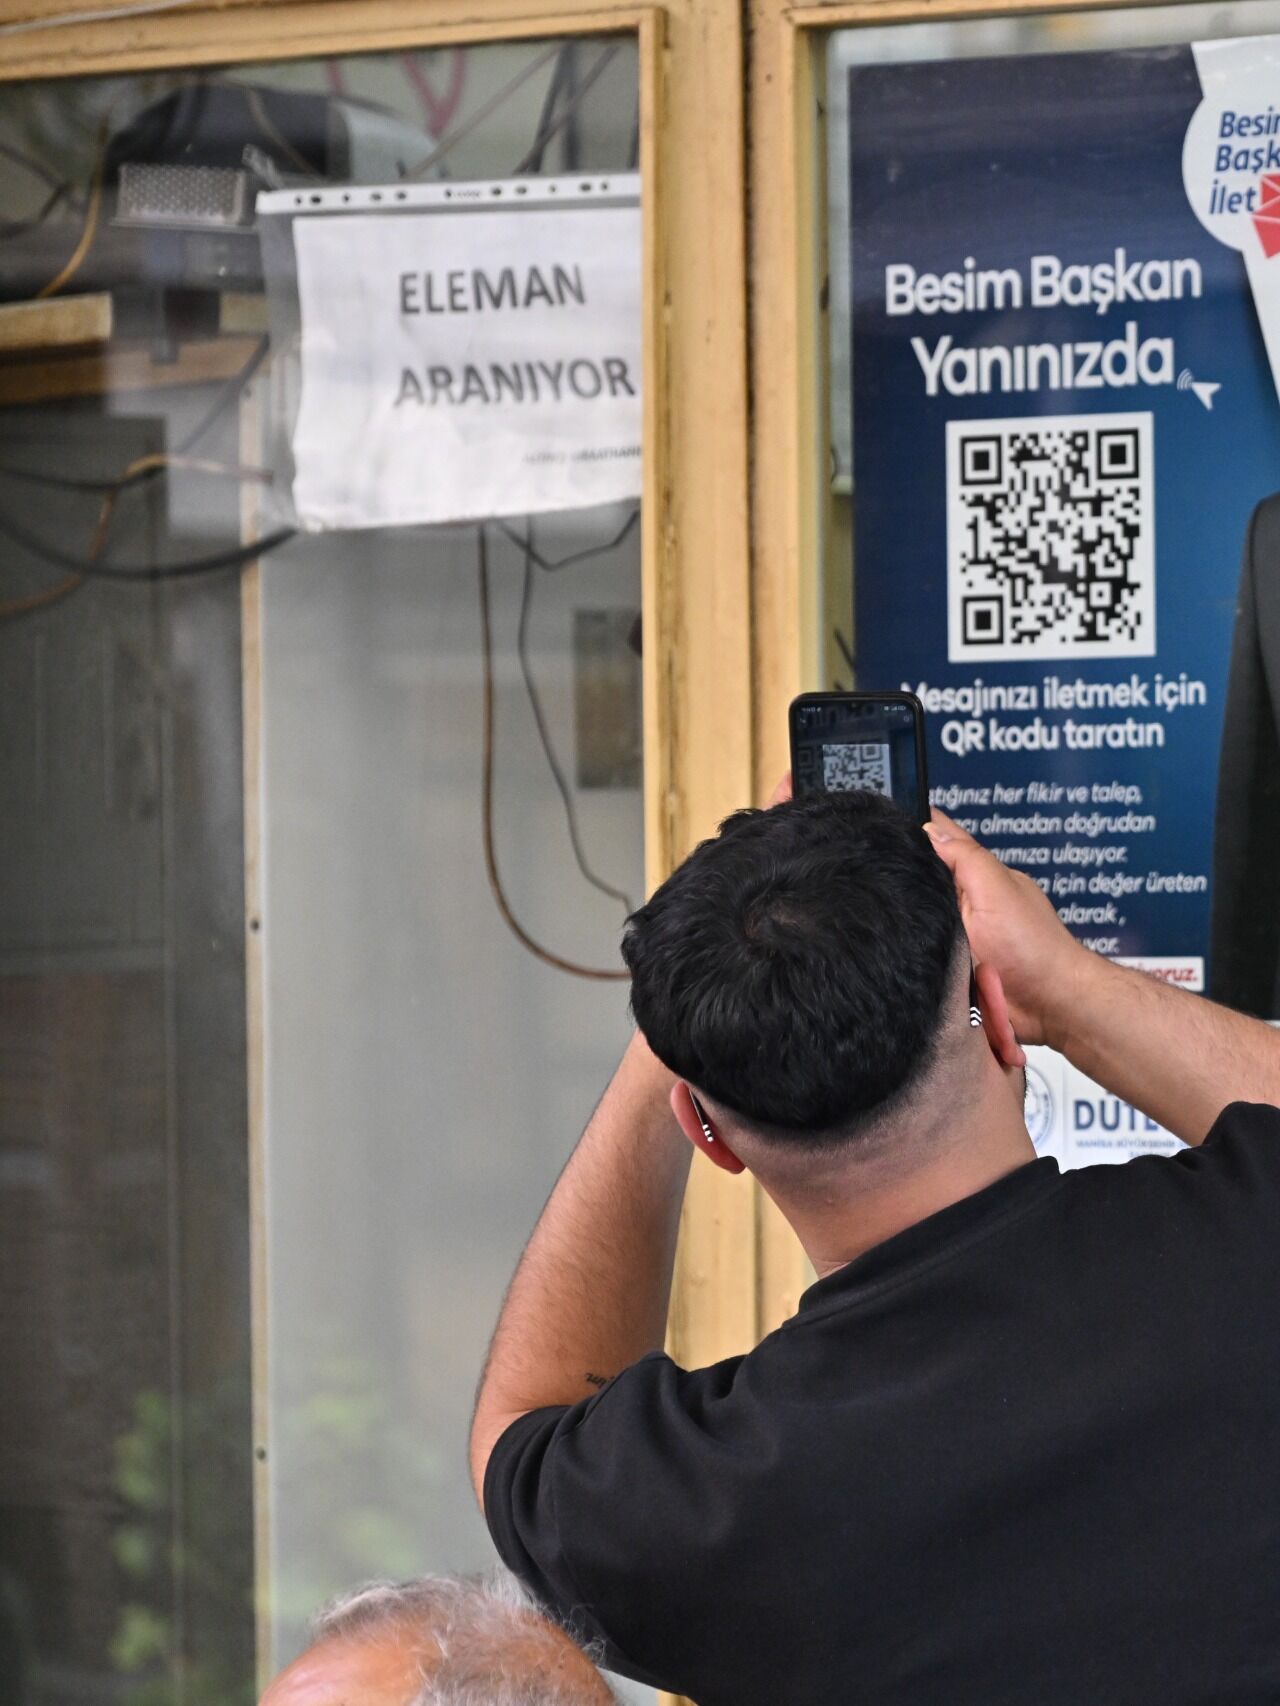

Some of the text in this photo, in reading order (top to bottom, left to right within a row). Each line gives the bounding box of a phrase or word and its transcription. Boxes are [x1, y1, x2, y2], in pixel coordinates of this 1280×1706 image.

[1209, 178, 1257, 214] İlet
[400, 263, 587, 314] ELEMAN
[885, 247, 1203, 315] Besim Başkan
[911, 320, 1174, 396] Yanınızda
[393, 357, 637, 408] ARANIYOR
[1043, 674, 1149, 710] iletmek
[1154, 672, 1207, 713] için
[940, 717, 1165, 758] QR kodu taratın
[993, 783, 1025, 805] her
[1027, 781, 1066, 804] fikir
[1067, 786, 1090, 804] ve
[980, 811, 1062, 835] olmadan
[1064, 811, 1157, 838] doğrudan
[1052, 872, 1087, 898] için
[1088, 871, 1144, 898] değer
[1145, 871, 1208, 894] üreten
[1057, 902, 1117, 924] alarak
